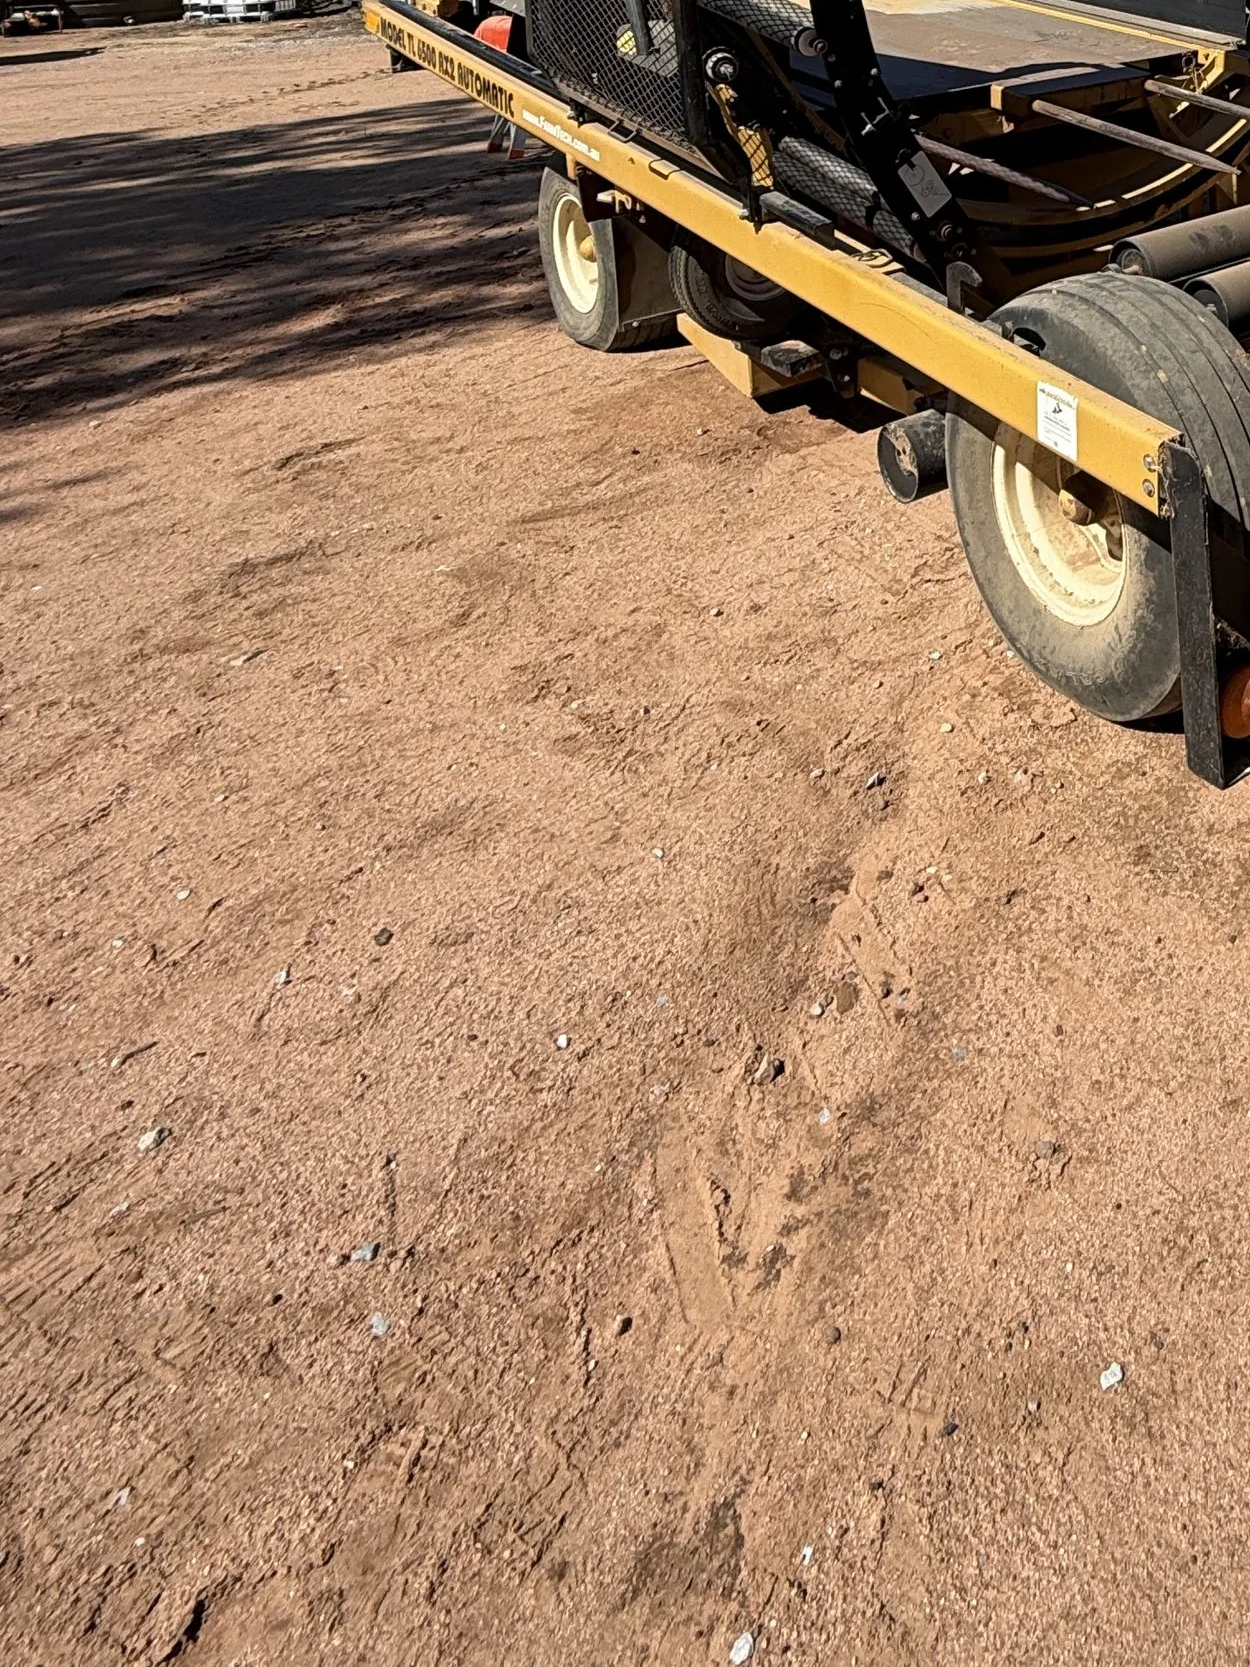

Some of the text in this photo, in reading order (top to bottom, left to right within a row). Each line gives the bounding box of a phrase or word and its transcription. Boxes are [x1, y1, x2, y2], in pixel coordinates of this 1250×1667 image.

[380, 16, 514, 118] MODEL TL 6500 AX2 AUTOMATIC
